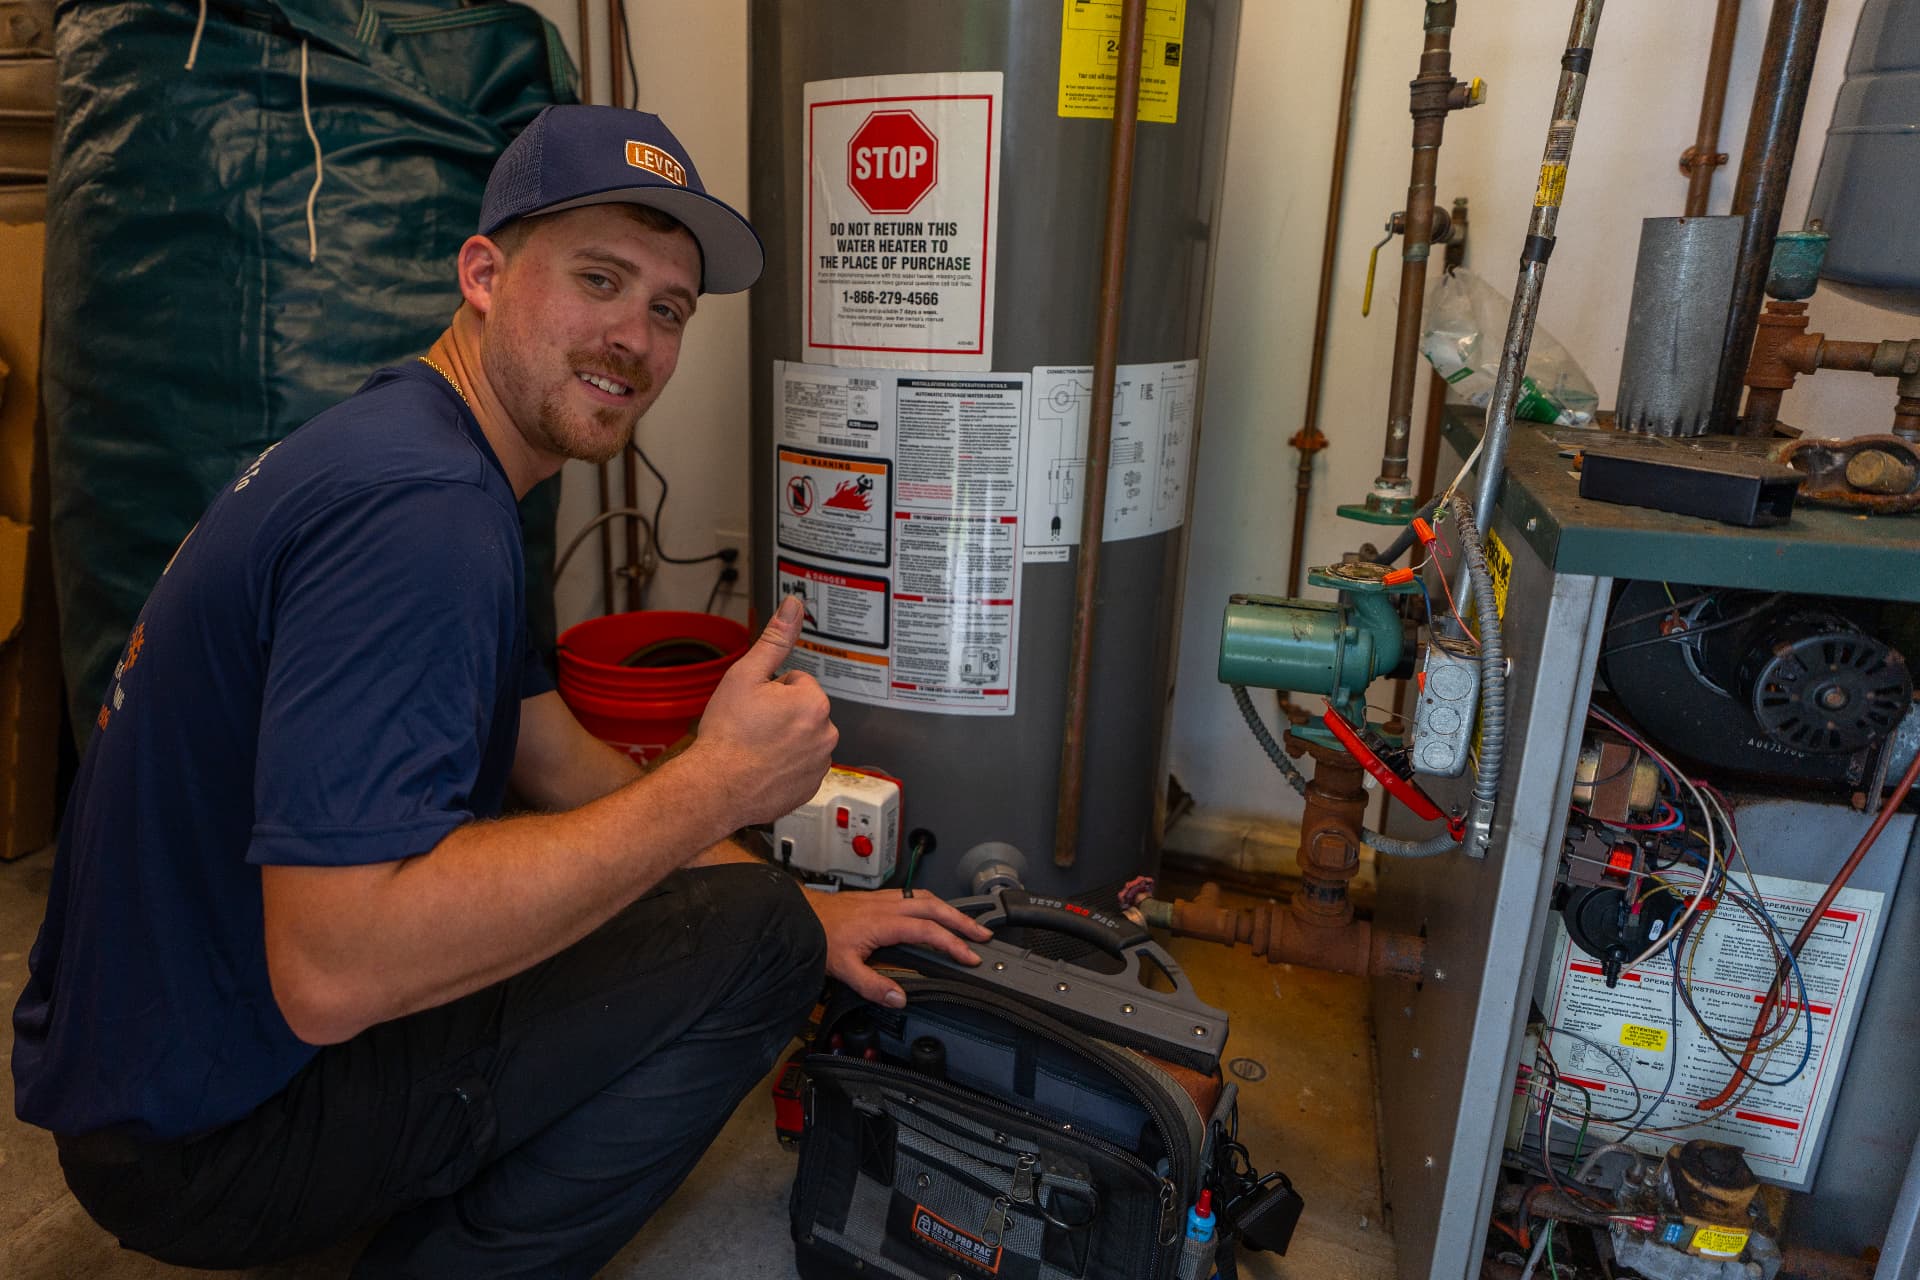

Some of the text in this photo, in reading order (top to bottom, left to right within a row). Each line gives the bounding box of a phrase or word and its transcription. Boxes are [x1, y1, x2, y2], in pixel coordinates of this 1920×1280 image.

[636, 147, 682, 184] LEVCO
[856, 146, 928, 180] STOP
[830, 222, 958, 236] DO NOT RETURN THIS
[837, 240, 948, 254] WATER HEATER TO
[820, 256, 972, 270] THE PLACE OF PURCHASE
[842, 290, 938, 306] 1-866-279-4566
[812, 458, 851, 470] WARNING
[813, 571, 847, 585] DANGER
[1029, 898, 1062, 908] VETO
[1065, 904, 1089, 916] PRO
[1764, 902, 1812, 914] OPERATING
[1644, 977, 1751, 1000] OPERAT INSTRUCTIONS
[1629, 1026, 1661, 1035] ATTENTION
[933, 1221, 992, 1257] VETO PRO PAC
